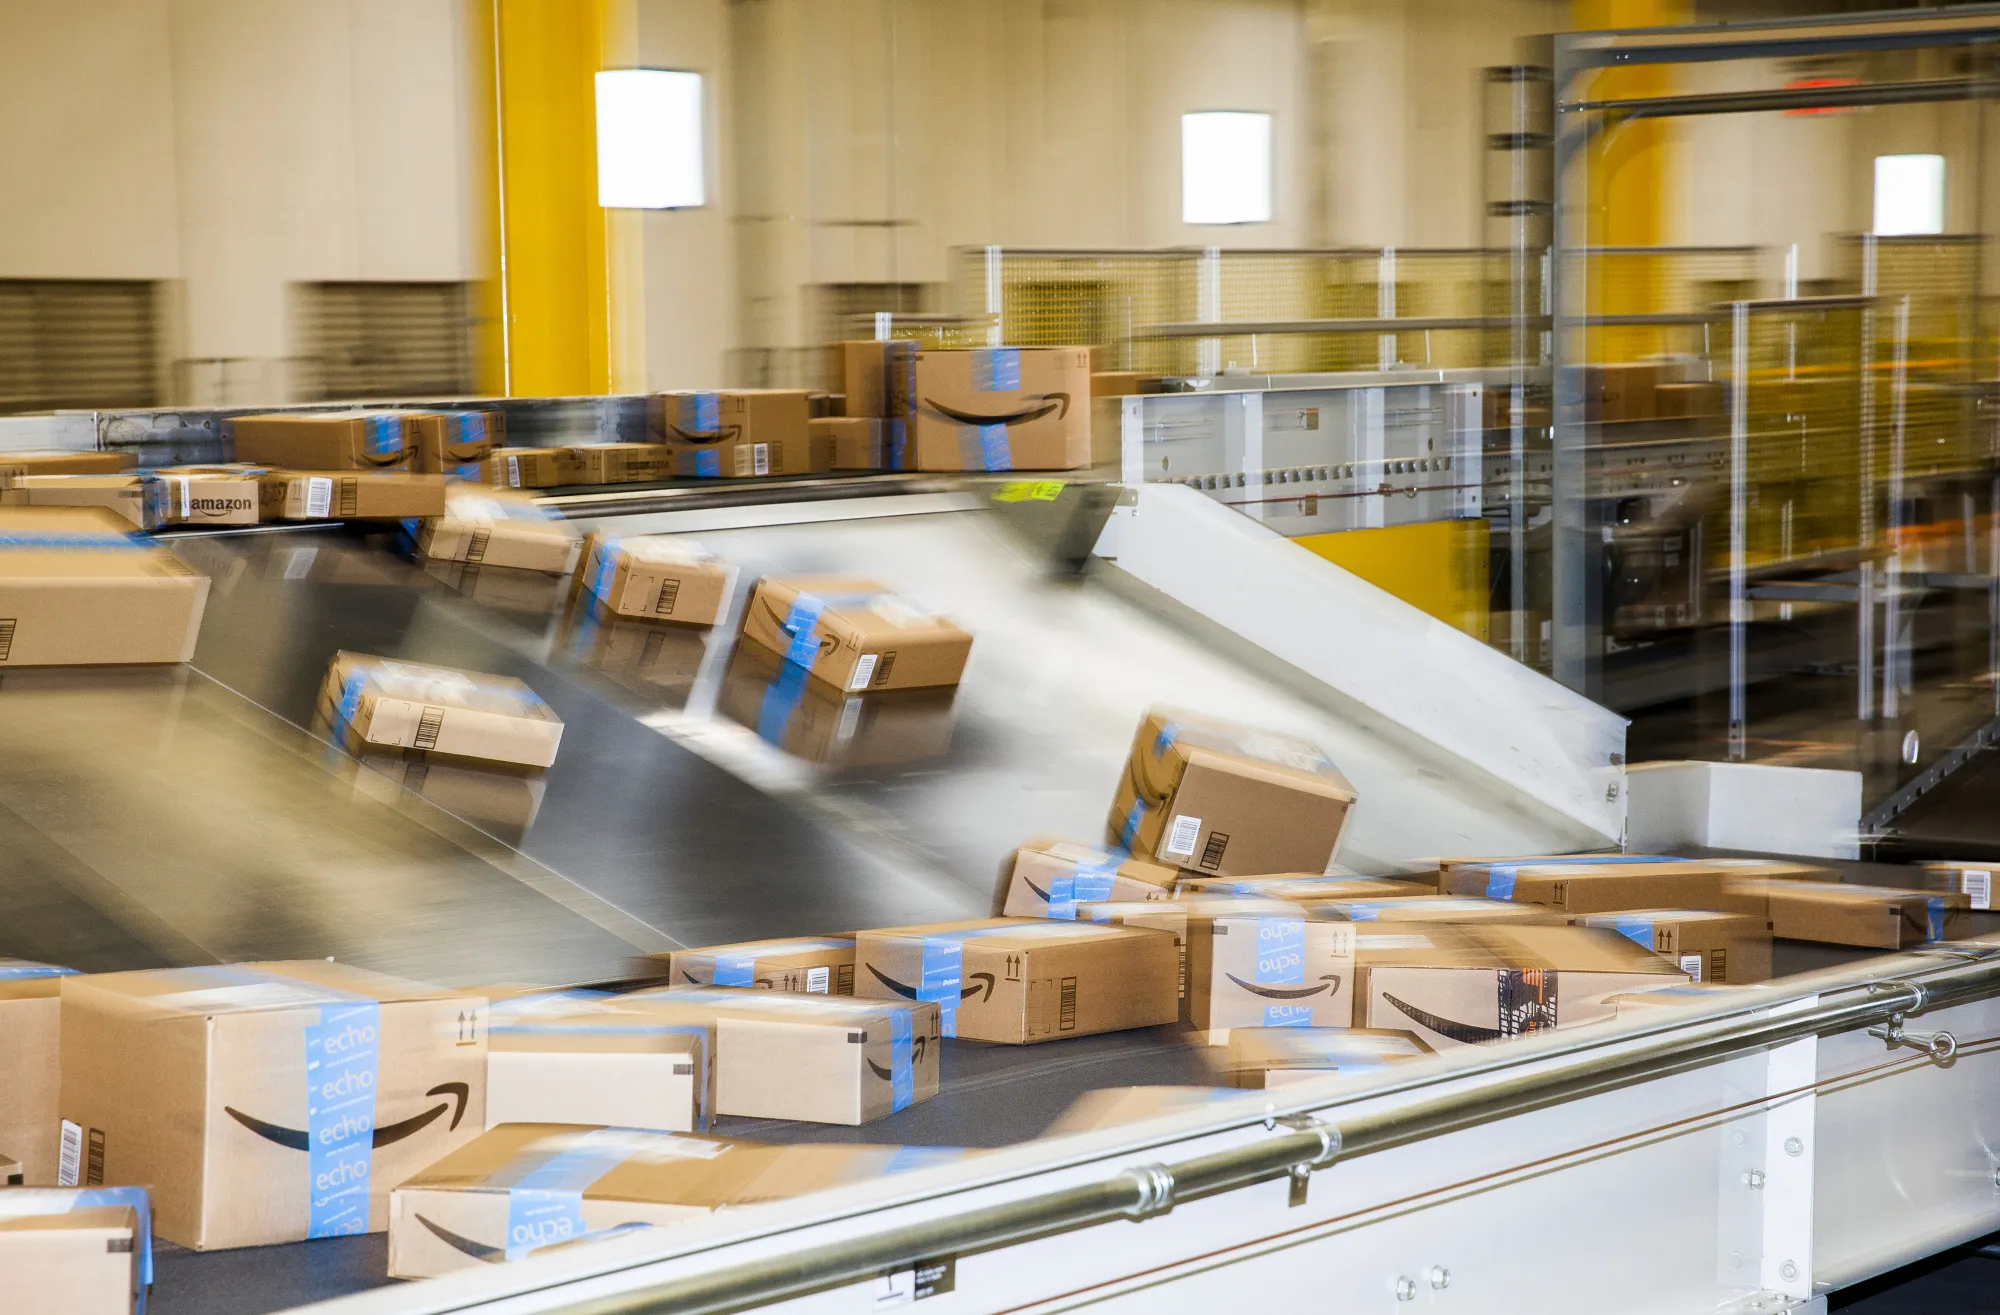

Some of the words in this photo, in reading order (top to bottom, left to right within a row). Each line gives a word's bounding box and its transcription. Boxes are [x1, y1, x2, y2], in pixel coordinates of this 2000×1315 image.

[191, 498, 252, 510] amazon
[1260, 921, 1301, 942] echo
[1260, 953, 1300, 973] echo
[324, 1023, 375, 1054] echo
[322, 1069, 374, 1100] echo
[319, 1114, 370, 1145] echo
[316, 1160, 367, 1190] echo
[513, 1217, 573, 1246] echo
